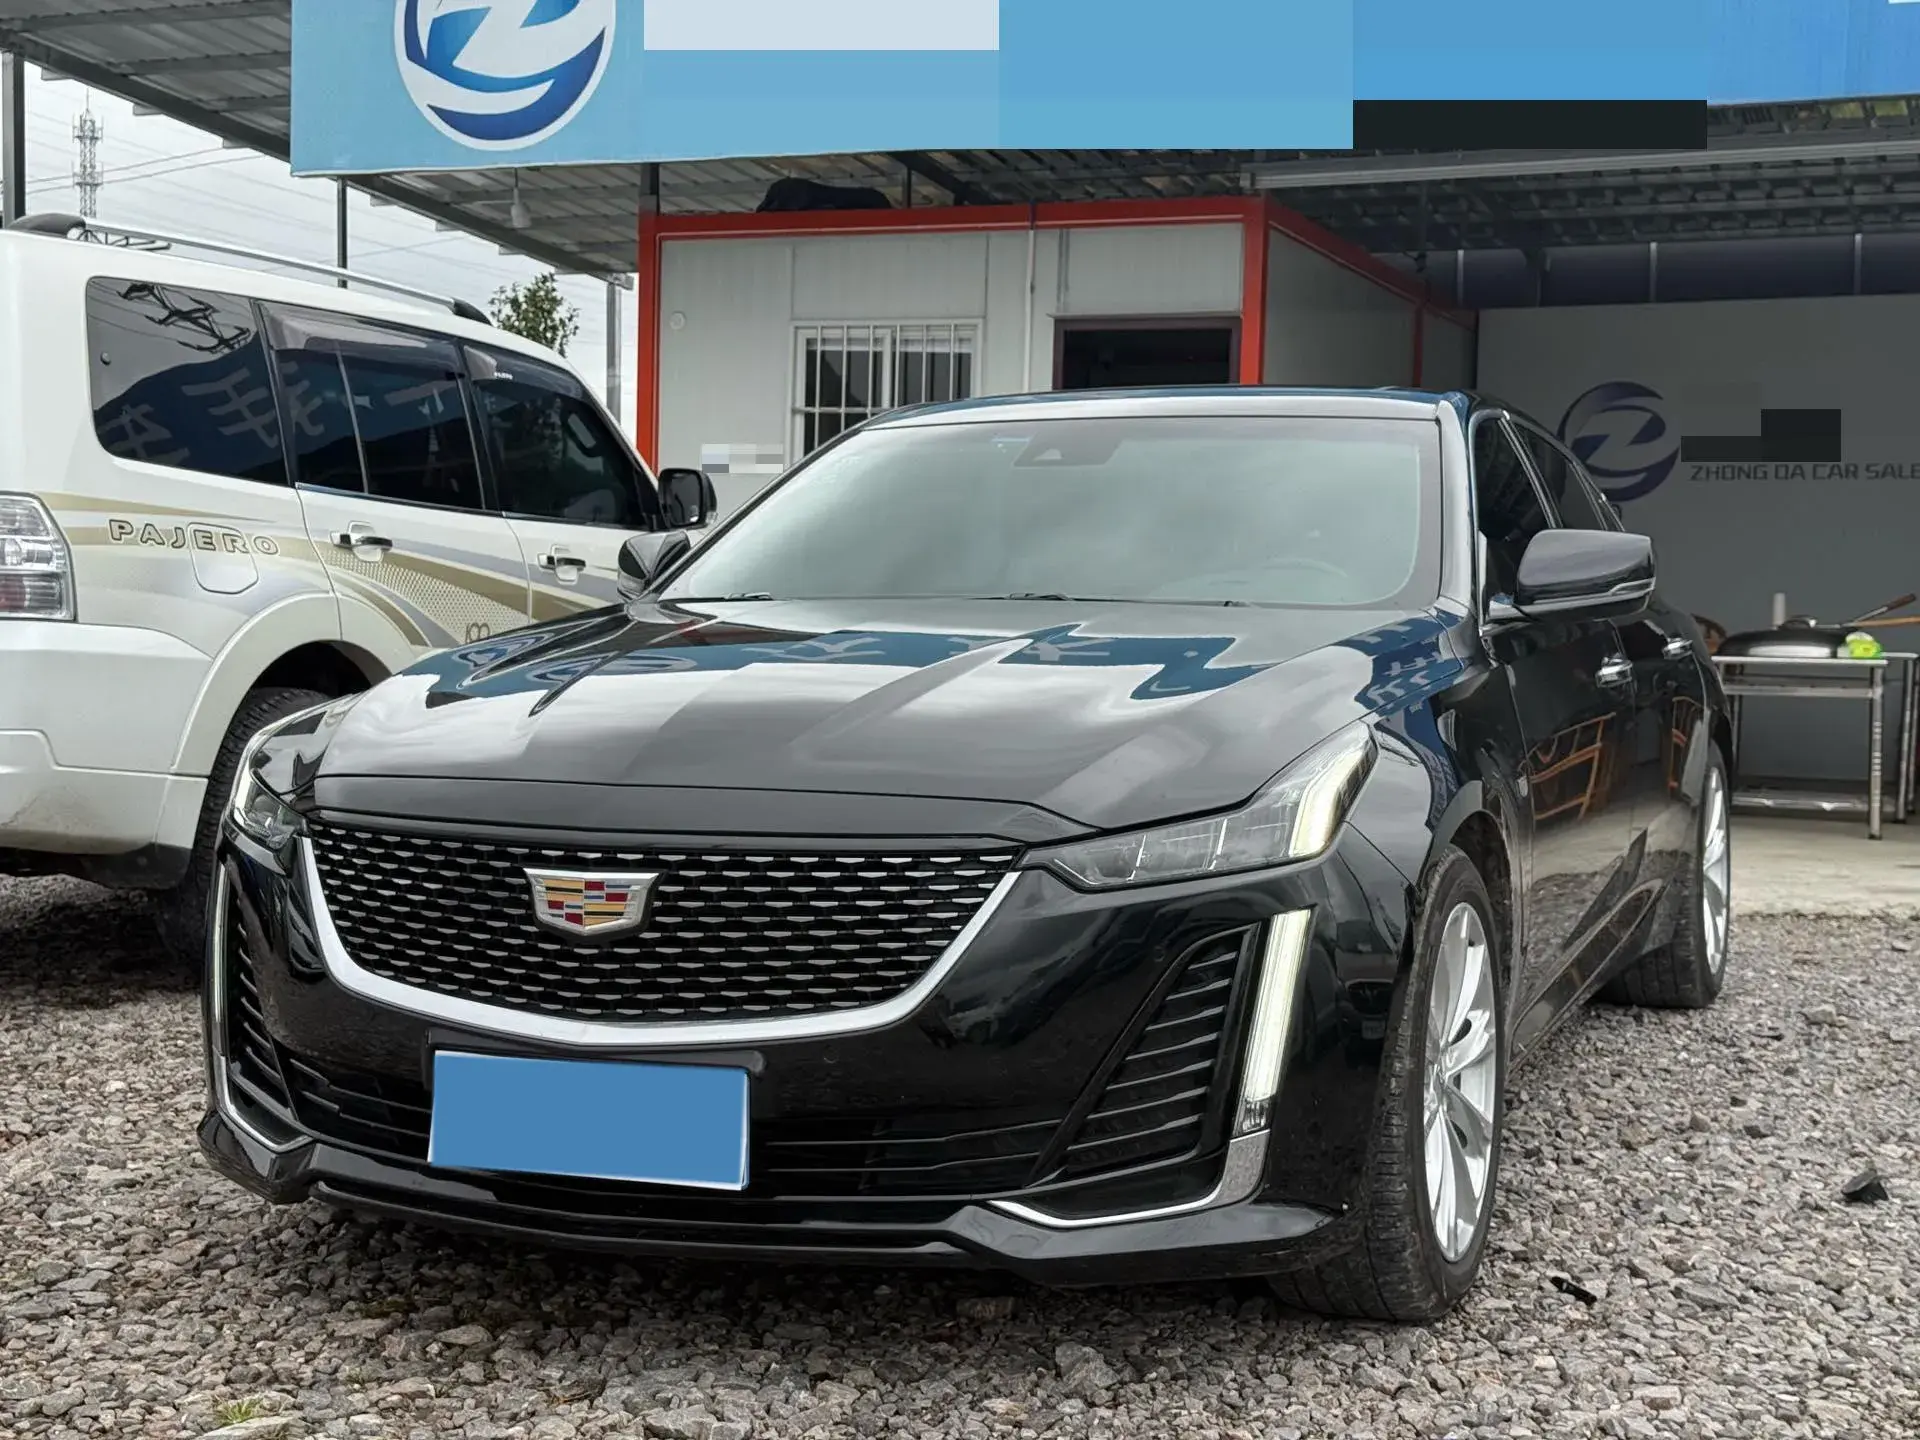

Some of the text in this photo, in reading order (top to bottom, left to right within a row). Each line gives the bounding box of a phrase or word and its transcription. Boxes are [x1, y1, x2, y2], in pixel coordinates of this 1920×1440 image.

[1690, 464, 1769, 482] ZHONG
[1811, 464, 1859, 481] CAR
[108, 518, 280, 556] PAJERO
